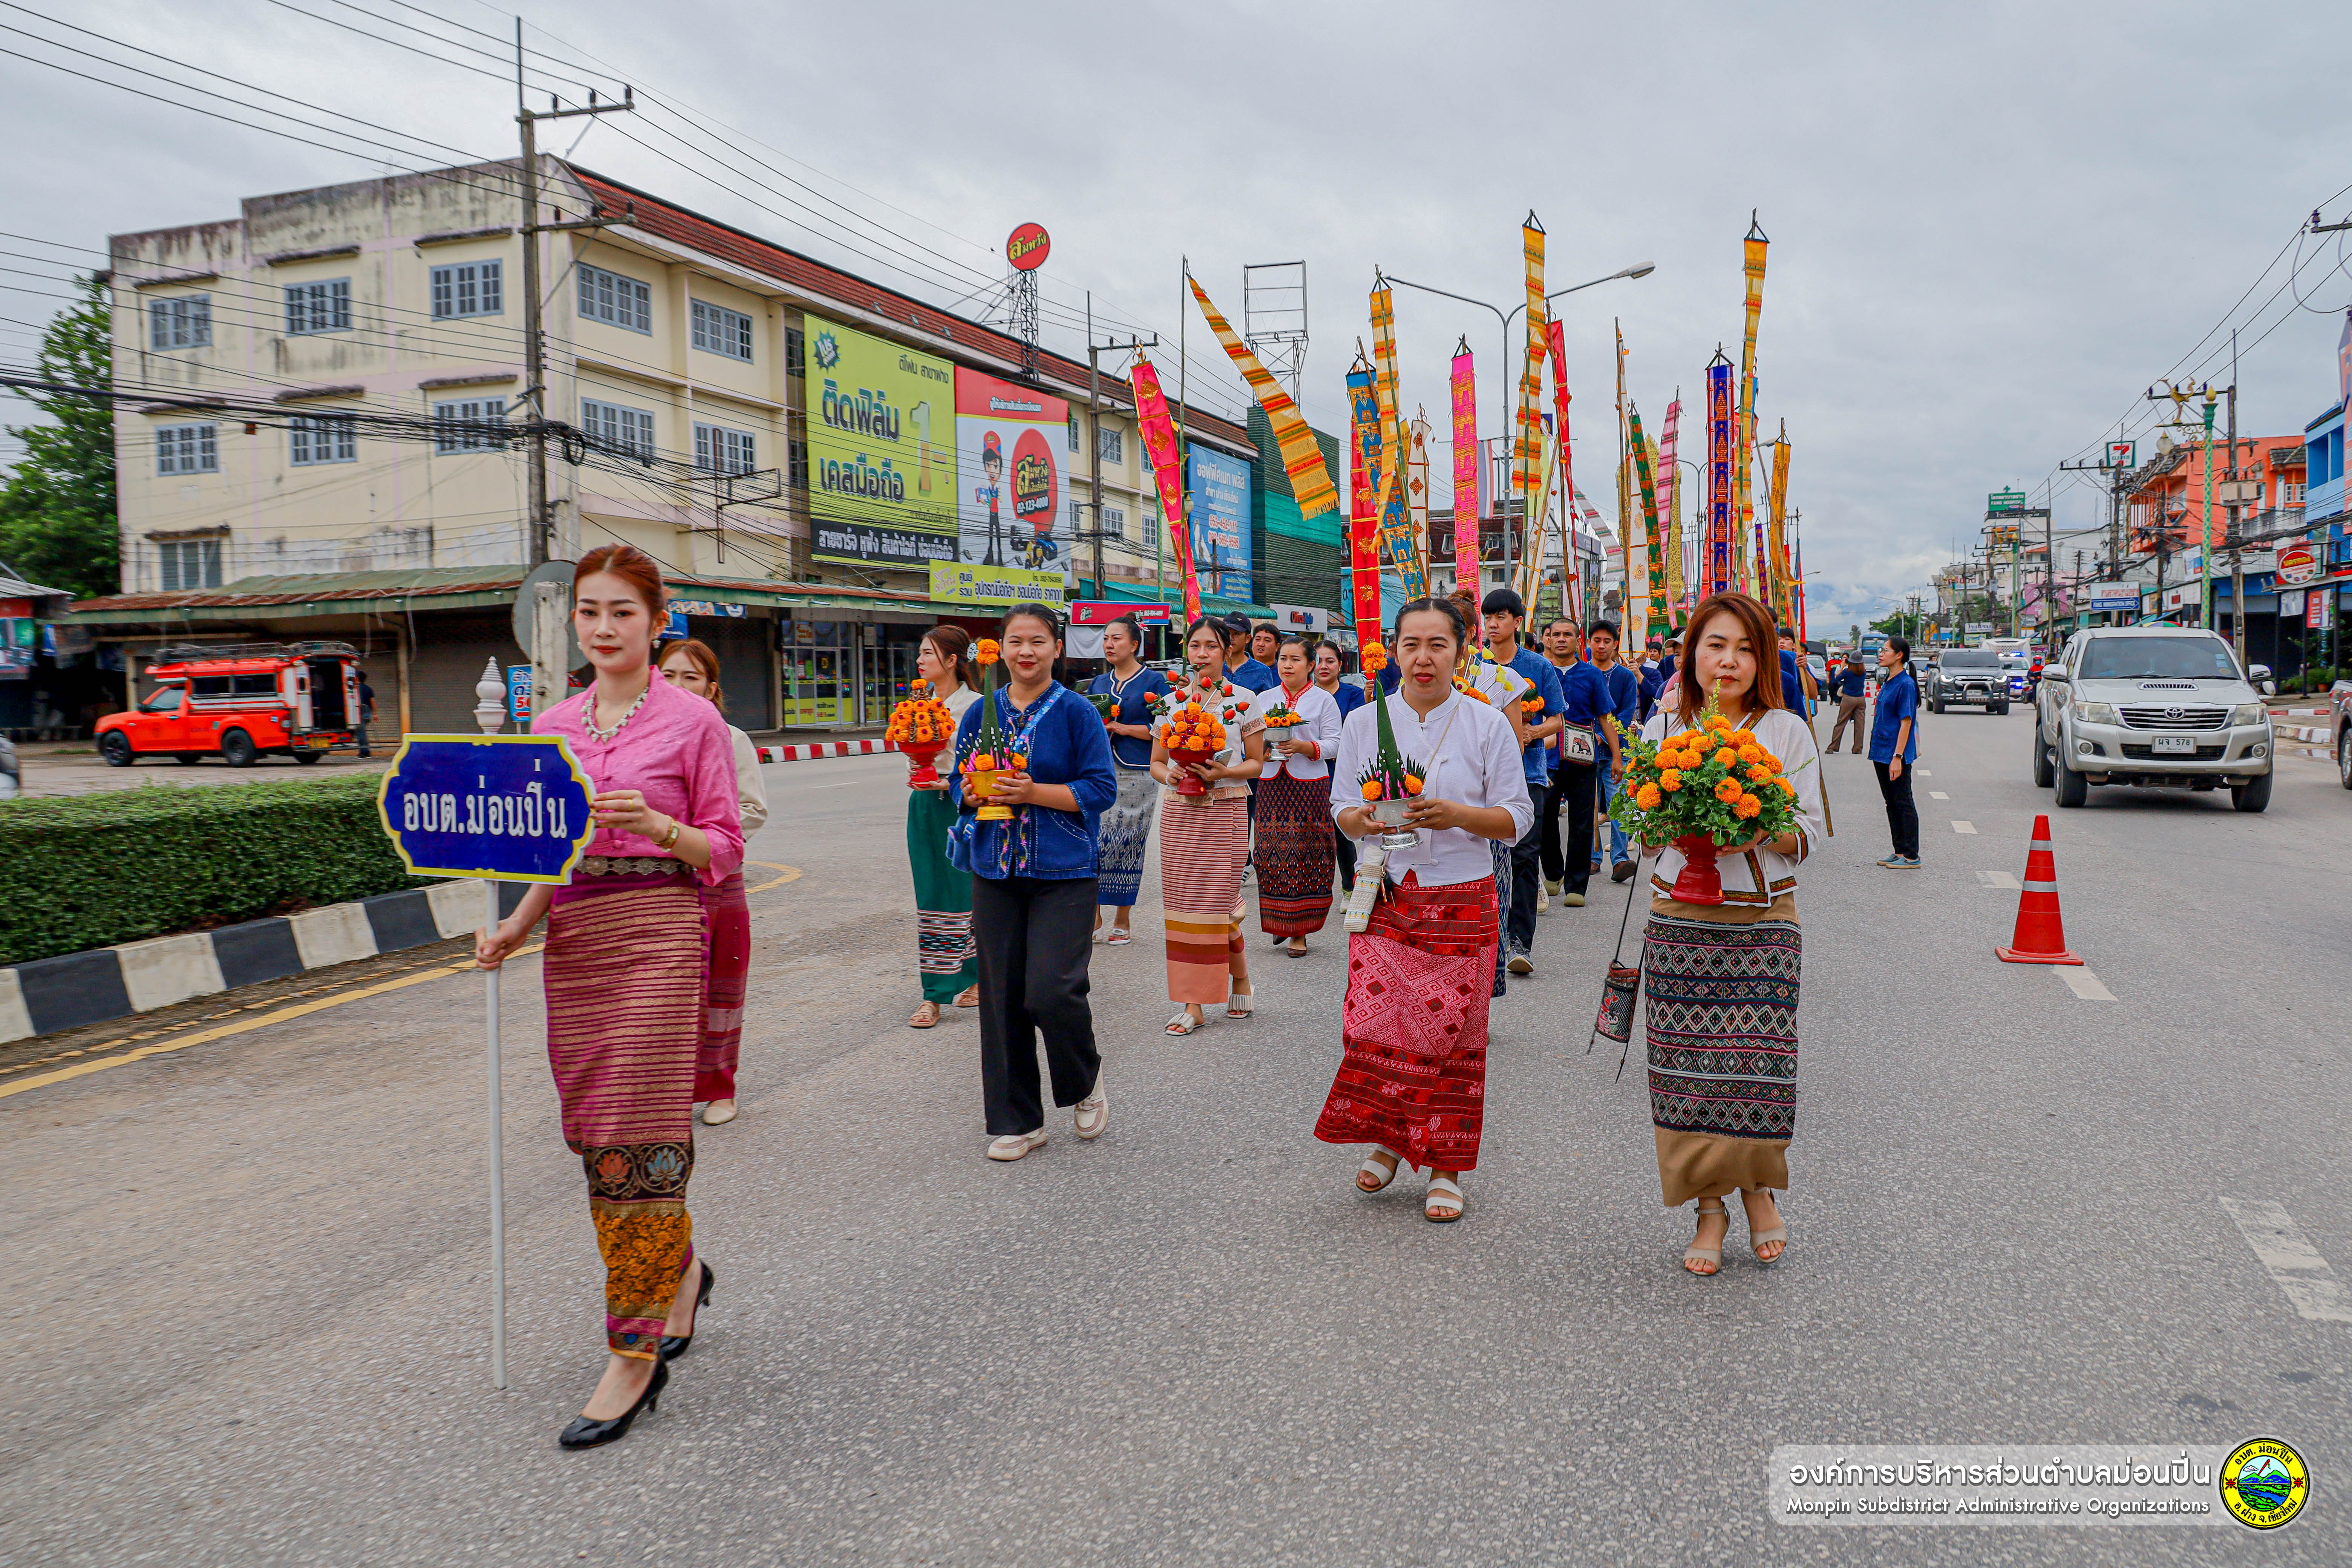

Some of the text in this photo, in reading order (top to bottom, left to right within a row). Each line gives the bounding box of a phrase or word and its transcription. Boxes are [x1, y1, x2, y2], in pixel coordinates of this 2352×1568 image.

[822, 377, 899, 442] ติดฟิล์ม
[819, 451, 905, 504] เคสมือถือ
[818, 527, 858, 551] สายชาร์จ
[403, 758, 568, 839] อบต.ม่อนปิ่น
